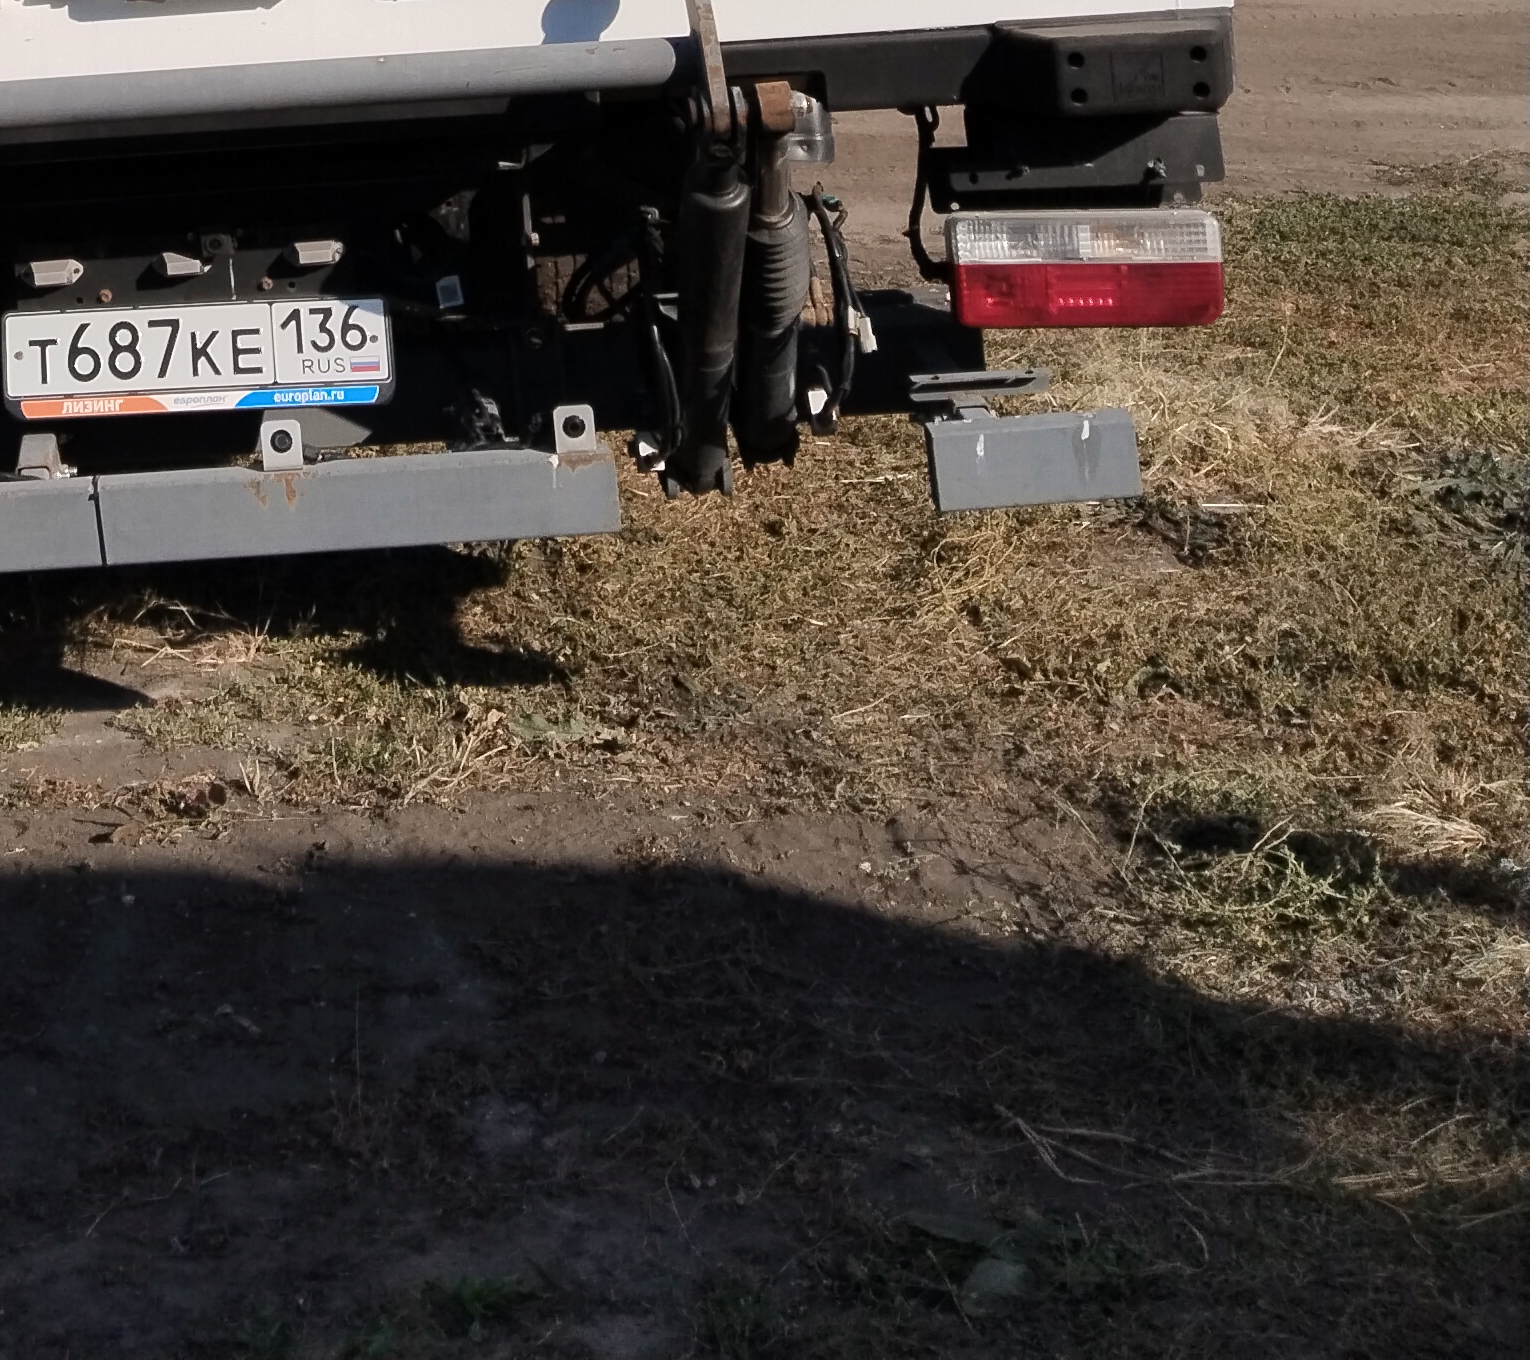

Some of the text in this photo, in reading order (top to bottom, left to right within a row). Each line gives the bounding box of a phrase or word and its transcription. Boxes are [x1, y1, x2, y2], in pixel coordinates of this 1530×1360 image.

[28, 304, 369, 385] Т687КЕ 136
[301, 358, 346, 374] RUS
[273, 389, 345, 405] europlan.ru
[62, 399, 125, 415] ЛИЗИНГ
